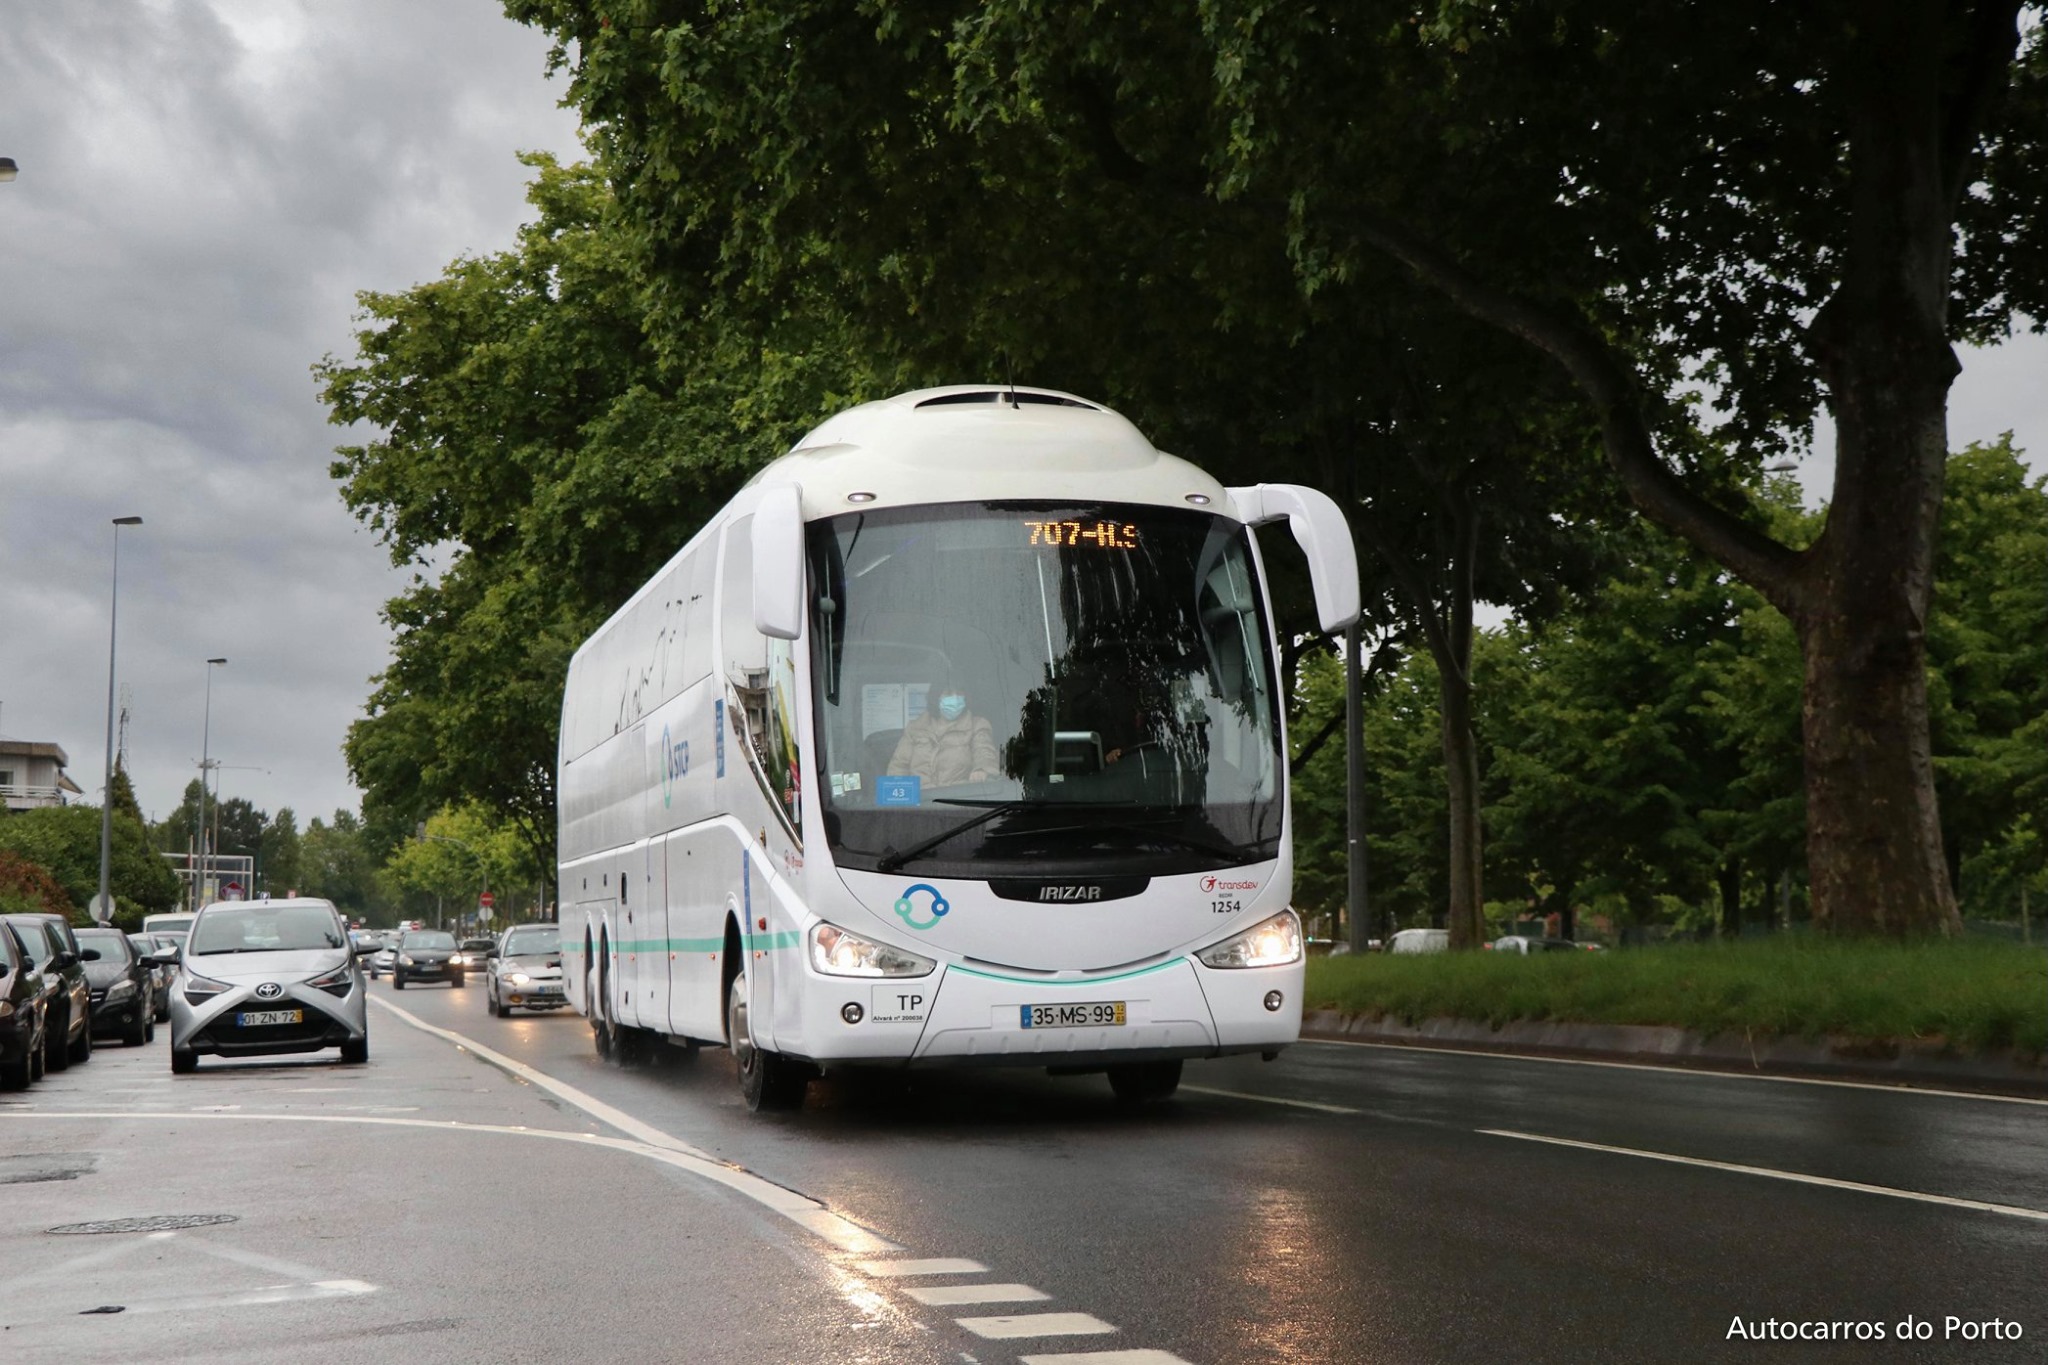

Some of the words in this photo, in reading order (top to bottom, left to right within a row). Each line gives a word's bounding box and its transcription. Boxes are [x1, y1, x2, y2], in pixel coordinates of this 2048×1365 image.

[892, 788, 906, 797] 43
[1218, 880, 1258, 890] transdev
[1040, 886, 1101, 900] IRIZAR
[1211, 900, 1241, 913] 1254
[897, 995, 922, 1010] TP
